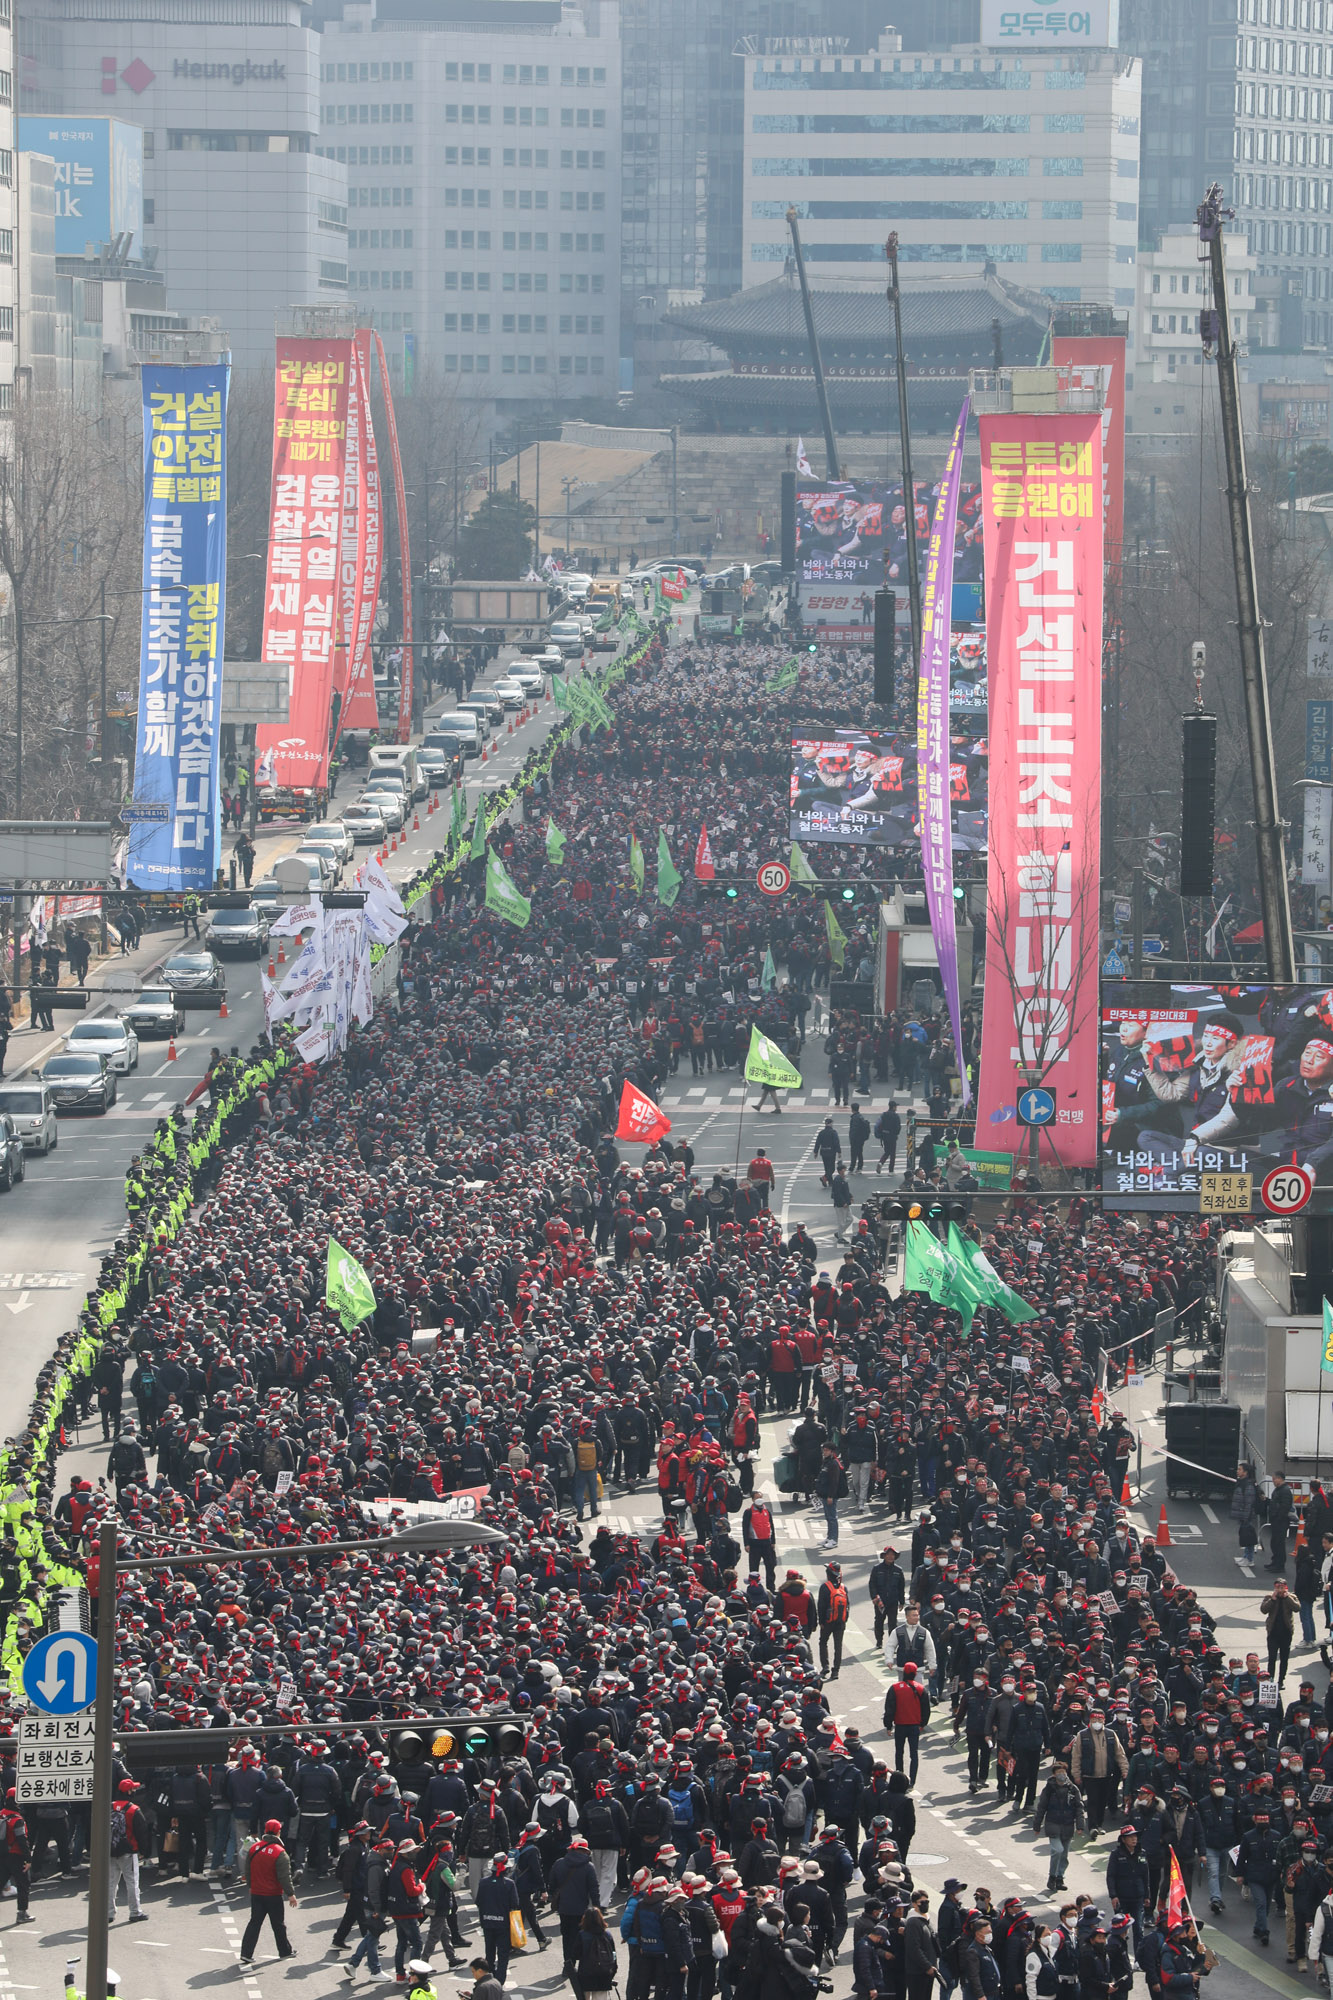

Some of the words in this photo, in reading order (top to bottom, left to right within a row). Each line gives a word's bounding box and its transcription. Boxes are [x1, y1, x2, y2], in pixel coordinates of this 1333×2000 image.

[999, 12, 1091, 36] 모두투어
[173, 58, 286, 84] Heungkuk
[61, 131, 94, 141] 한국제지
[280, 360, 345, 384] 건설의
[150, 391, 222, 431] 건설
[286, 387, 337, 412] 뚝심!
[276, 418, 345, 440] 공무원의
[151, 434, 222, 473] 안전
[290, 441, 331, 462] 패기!
[989, 441, 1093, 477] 든든해
[152, 476, 221, 503] 특별법
[991, 482, 1093, 518] 응원해
[307, 474, 341, 580] 윤석열
[268, 474, 307, 616] 검찰독재
[803, 560, 822, 569] 너와
[825, 560, 834, 569] 나
[837, 560, 857, 569] 너와
[859, 560, 869, 570] 나
[803, 570, 823, 580] 철의
[825, 570, 853, 580] 노동자
[146, 514, 183, 685] 금속노조가
[807, 597, 850, 610] 당당한
[300, 594, 334, 663] 심판
[1014, 540, 1076, 829] 건설노조
[143, 691, 180, 757] 함께
[173, 582, 219, 851] 쟁취하겠습니다
[1307, 766, 1330, 776] 가모
[799, 811, 824, 822] 너와
[827, 812, 840, 823] 나
[844, 813, 869, 825] 너와
[872, 815, 885, 826] 나
[799, 821, 823, 833] 철의
[827, 823, 864, 835] 노동자
[147, 865, 206, 876] 전국금속노동조합
[764, 870, 784, 888] 50
[1010, 847, 1073, 1062] 힘내요
[1110, 1010, 1148, 1020] 민주노총
[1150, 1011, 1188, 1021] 결의대회
[1056, 1109, 1084, 1124] 연맹
[1117, 1150, 1155, 1169] 너와
[1160, 1151, 1180, 1171] 나
[1187, 1151, 1224, 1172] 너와
[1229, 1153, 1249, 1172] 나
[1117, 1173, 1154, 1192] 철의
[1162, 1174, 1202, 1192] 노동
[1272, 1179, 1301, 1202] 50
[1203, 1195, 1249, 1209] 직좌신호
[20, 1778, 70, 1798] 승용차에
